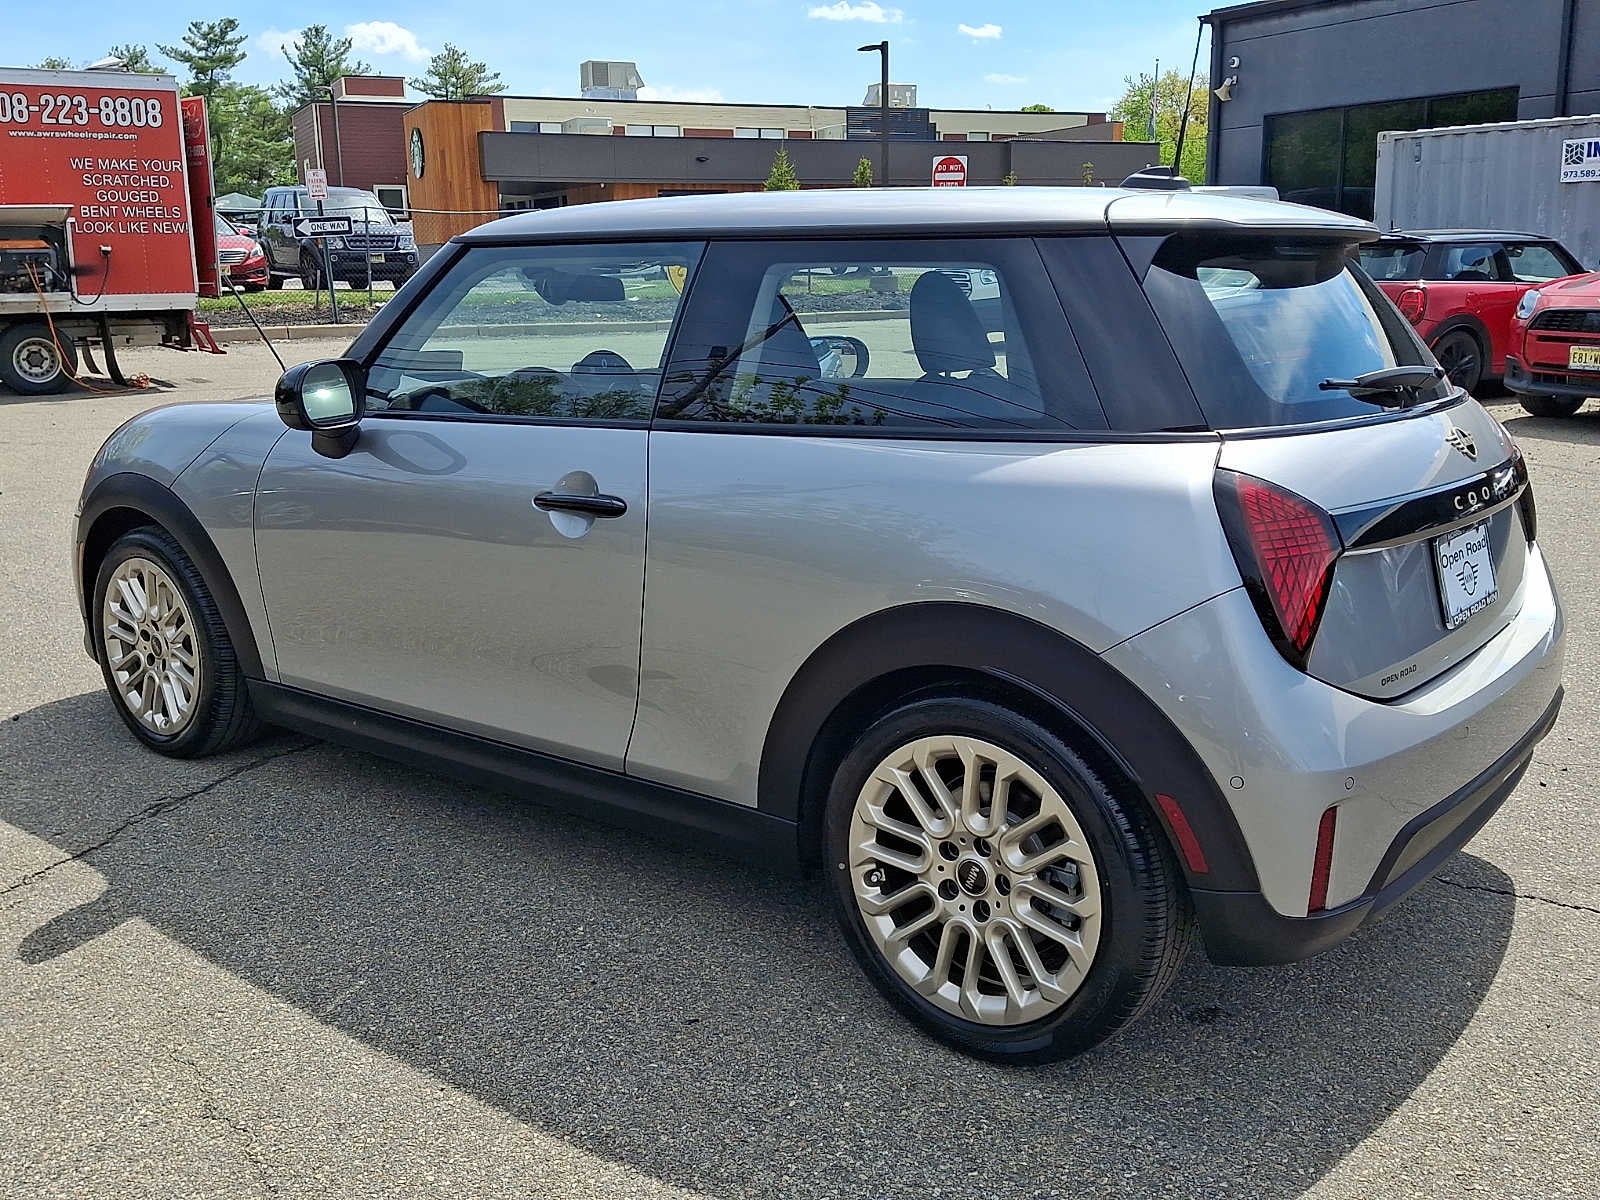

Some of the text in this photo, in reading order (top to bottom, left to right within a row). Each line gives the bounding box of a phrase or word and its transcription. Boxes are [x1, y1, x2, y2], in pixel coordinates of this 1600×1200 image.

[70, 158, 183, 172] WE MAKE YOUR
[82, 173, 174, 188] SCRATCHED,
[96, 190, 163, 204] GOUGED,
[80, 205, 181, 219] BENT WHEELS
[75, 221, 189, 234] LOOK LIKE NEW!
[310, 222, 346, 231] ONE WAY
[1441, 549, 1464, 570] Open
[1466, 536, 1487, 556] Road
[1454, 608, 1472, 624] OPEN
[1470, 599, 1488, 618] ROAD
[1381, 664, 1417, 686] OPEN ROAD
[965, 866, 979, 889] MINI
